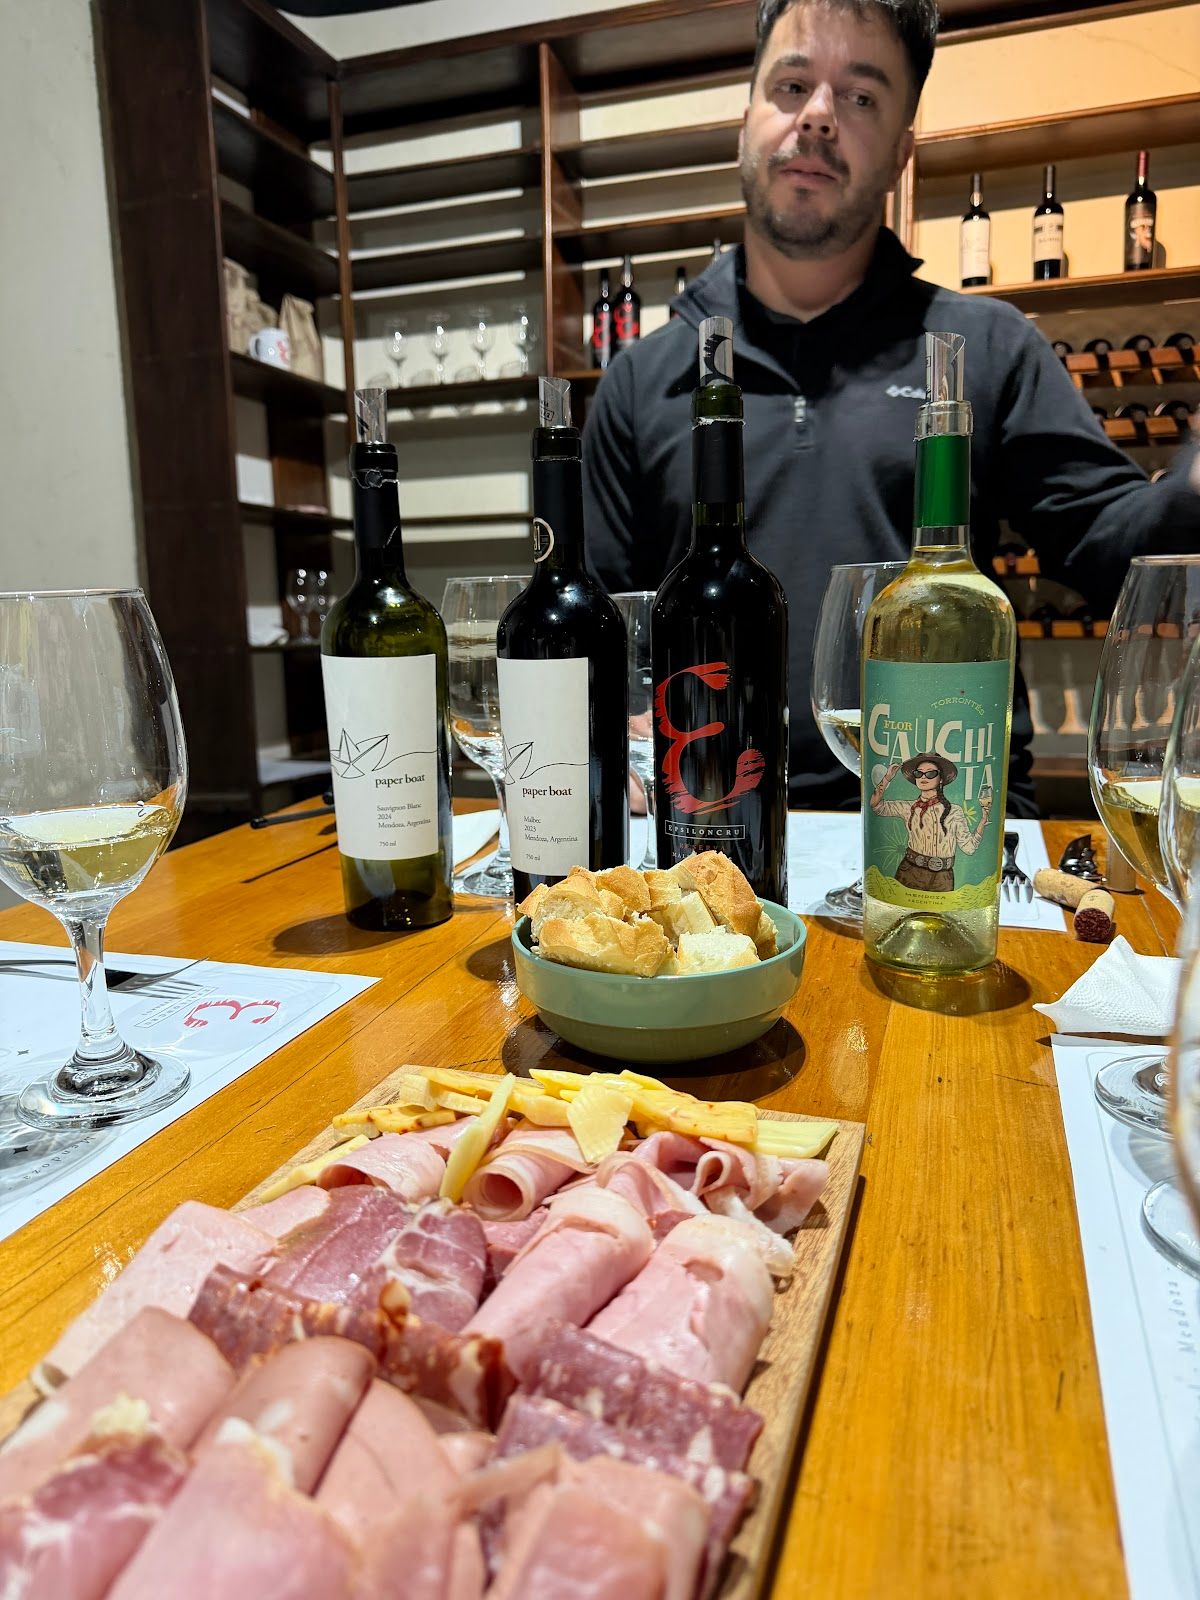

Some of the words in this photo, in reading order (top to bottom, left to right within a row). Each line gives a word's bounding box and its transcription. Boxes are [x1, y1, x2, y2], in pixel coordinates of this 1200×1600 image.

[931, 697, 985, 716] TORRONTÉS
[883, 719, 913, 731] FLOR
[375, 777, 403, 788] paper
[405, 773, 426, 784] boat
[522, 787, 547, 798] paper
[549, 785, 573, 796] boat
[377, 804, 406, 812] Sauvignon
[524, 816, 541, 824] Malbec
[668, 824, 740, 836] EPSILONCRU
